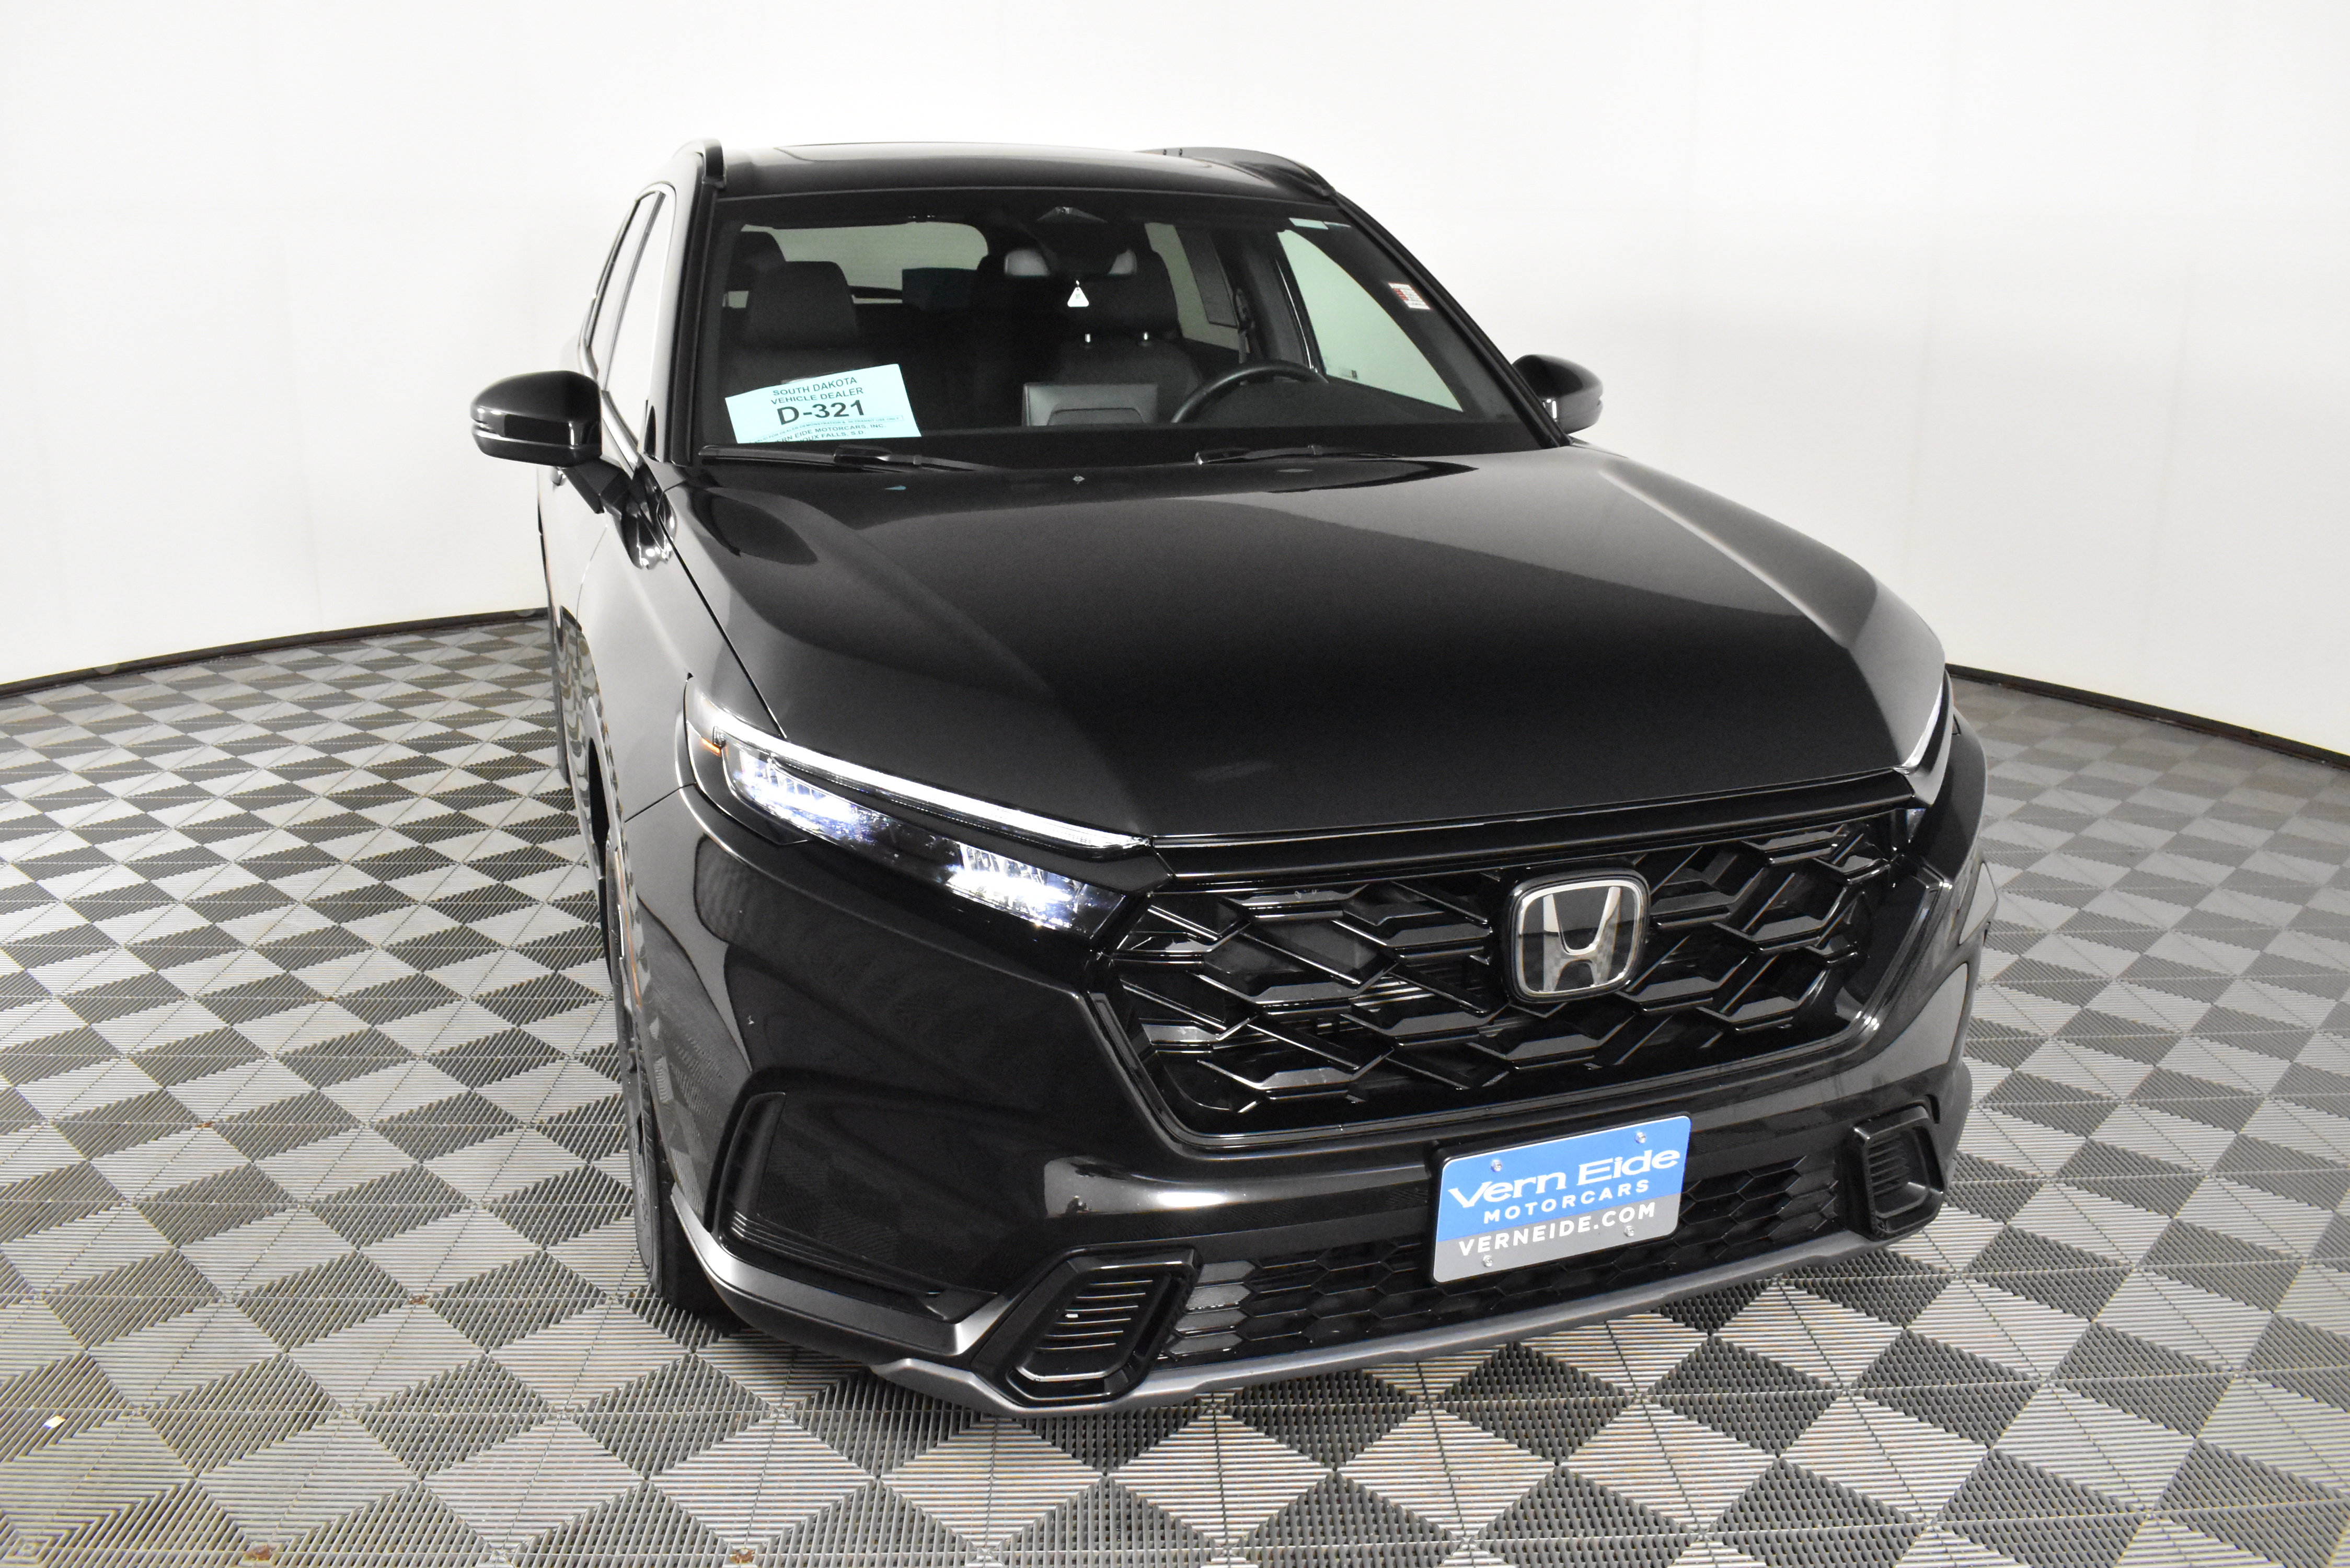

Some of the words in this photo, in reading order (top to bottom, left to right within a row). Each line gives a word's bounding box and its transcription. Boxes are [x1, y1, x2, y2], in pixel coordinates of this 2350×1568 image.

[770, 395, 817, 405] VEHICLE
[820, 387, 863, 400] DEALER
[773, 386, 810, 396] SOUTH
[813, 377, 857, 391] DAKOTA
[777, 399, 864, 425] D-321
[779, 426, 798, 435] DEALER
[794, 429, 813, 438] EIDE
[1448, 1171, 1566, 1208] Vern
[1576, 1149, 1680, 1185] Eide
[1483, 1179, 1650, 1225] MOTORCARS
[1458, 1202, 1655, 1256] VERNEIDE.COM
